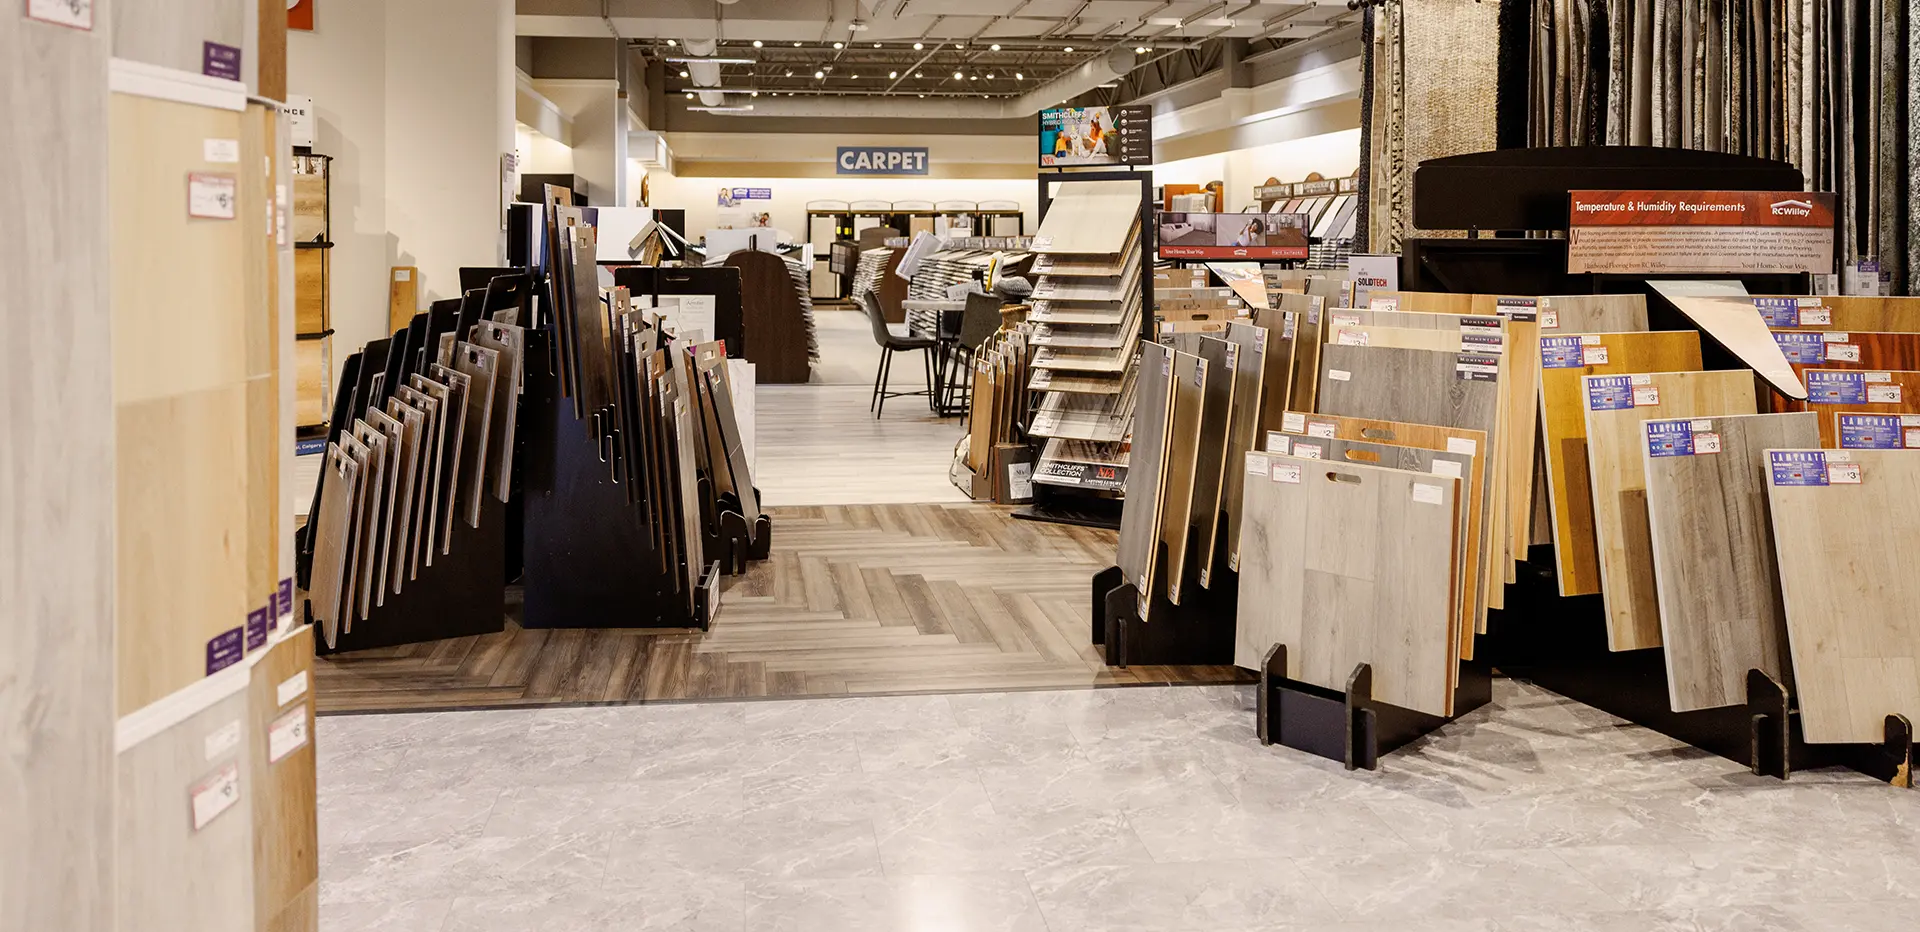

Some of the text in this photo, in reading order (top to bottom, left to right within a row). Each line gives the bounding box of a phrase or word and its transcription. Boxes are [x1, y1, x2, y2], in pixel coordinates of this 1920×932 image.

[1042, 111, 1086, 120] SMITHCLIFFS
[840, 151, 925, 170] CARPET
[1576, 201, 1746, 213] Temperature & Humidity Requirements
[1358, 278, 1387, 287] SOLIDTECH
[1040, 468, 1082, 477] COLLECTION
